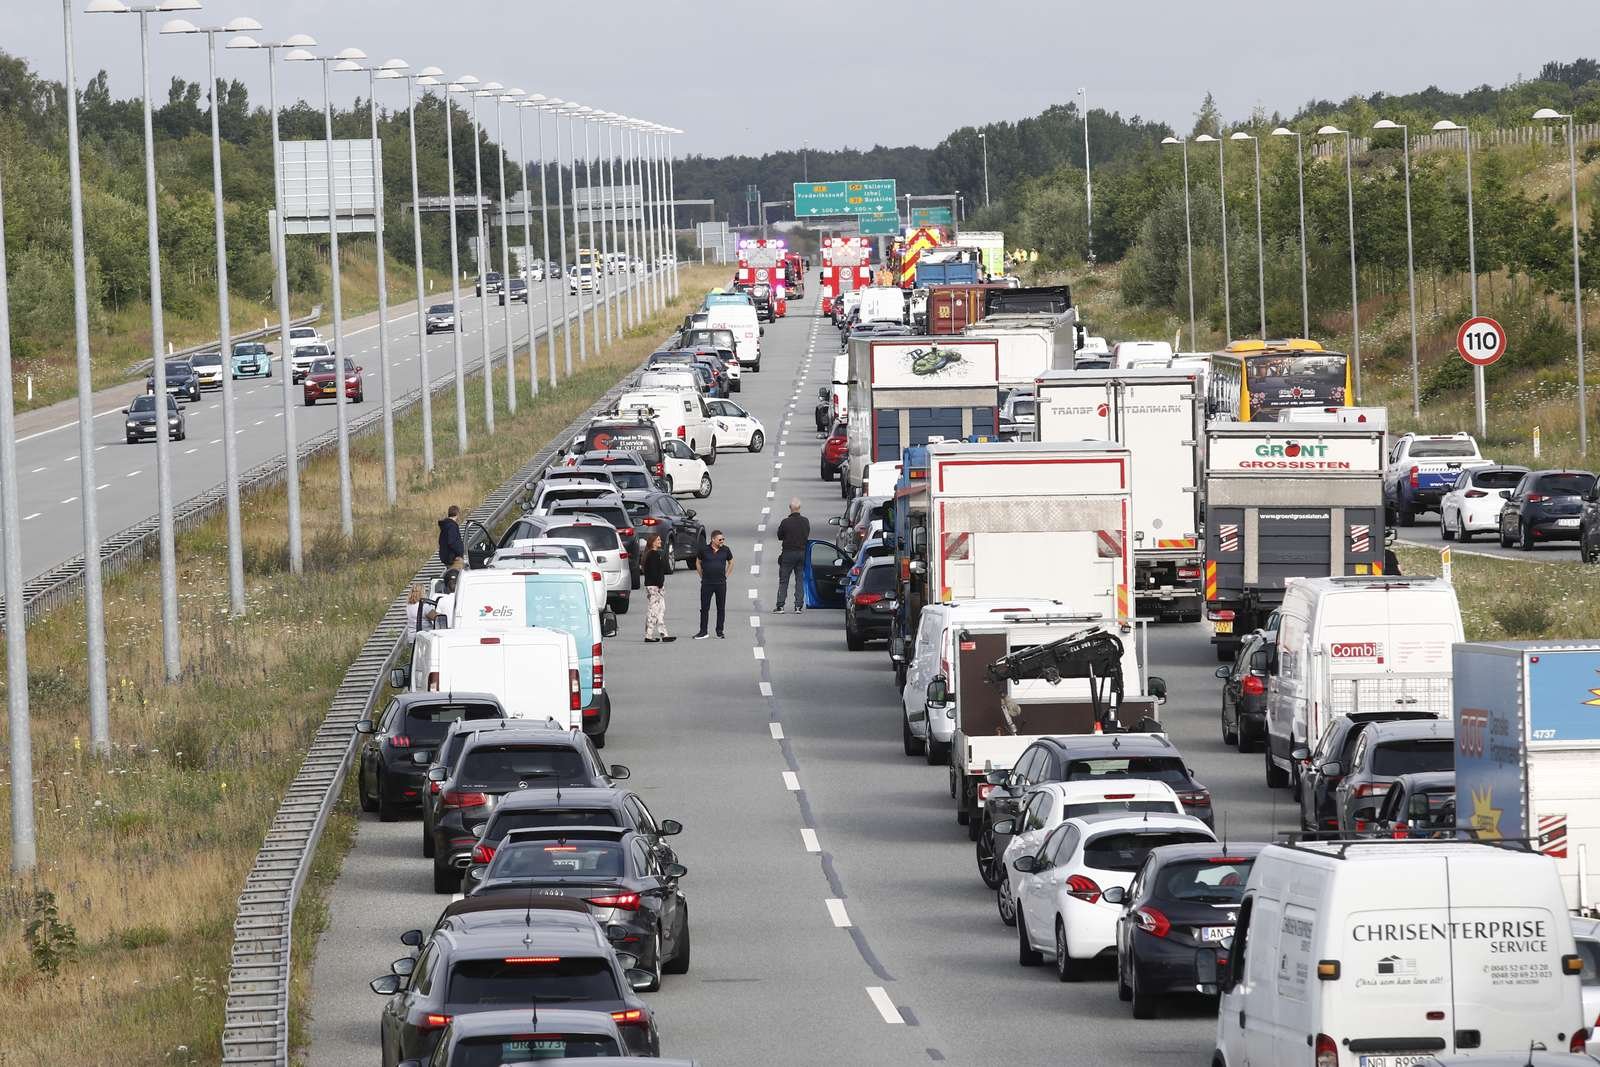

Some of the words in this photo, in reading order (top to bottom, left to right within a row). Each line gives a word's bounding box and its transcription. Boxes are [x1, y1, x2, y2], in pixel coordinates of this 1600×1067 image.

[1466, 332, 1497, 350] 110
[1239, 461, 1350, 469] GROSSISTEN
[492, 605, 513, 617] elis
[1331, 643, 1376, 657] Combi
[1532, 730, 1556, 739] 4737
[1210, 928, 1223, 938] AN
[1353, 921, 1546, 941] CHRISENTERPRISE
[1490, 940, 1548, 953] SERVICE
